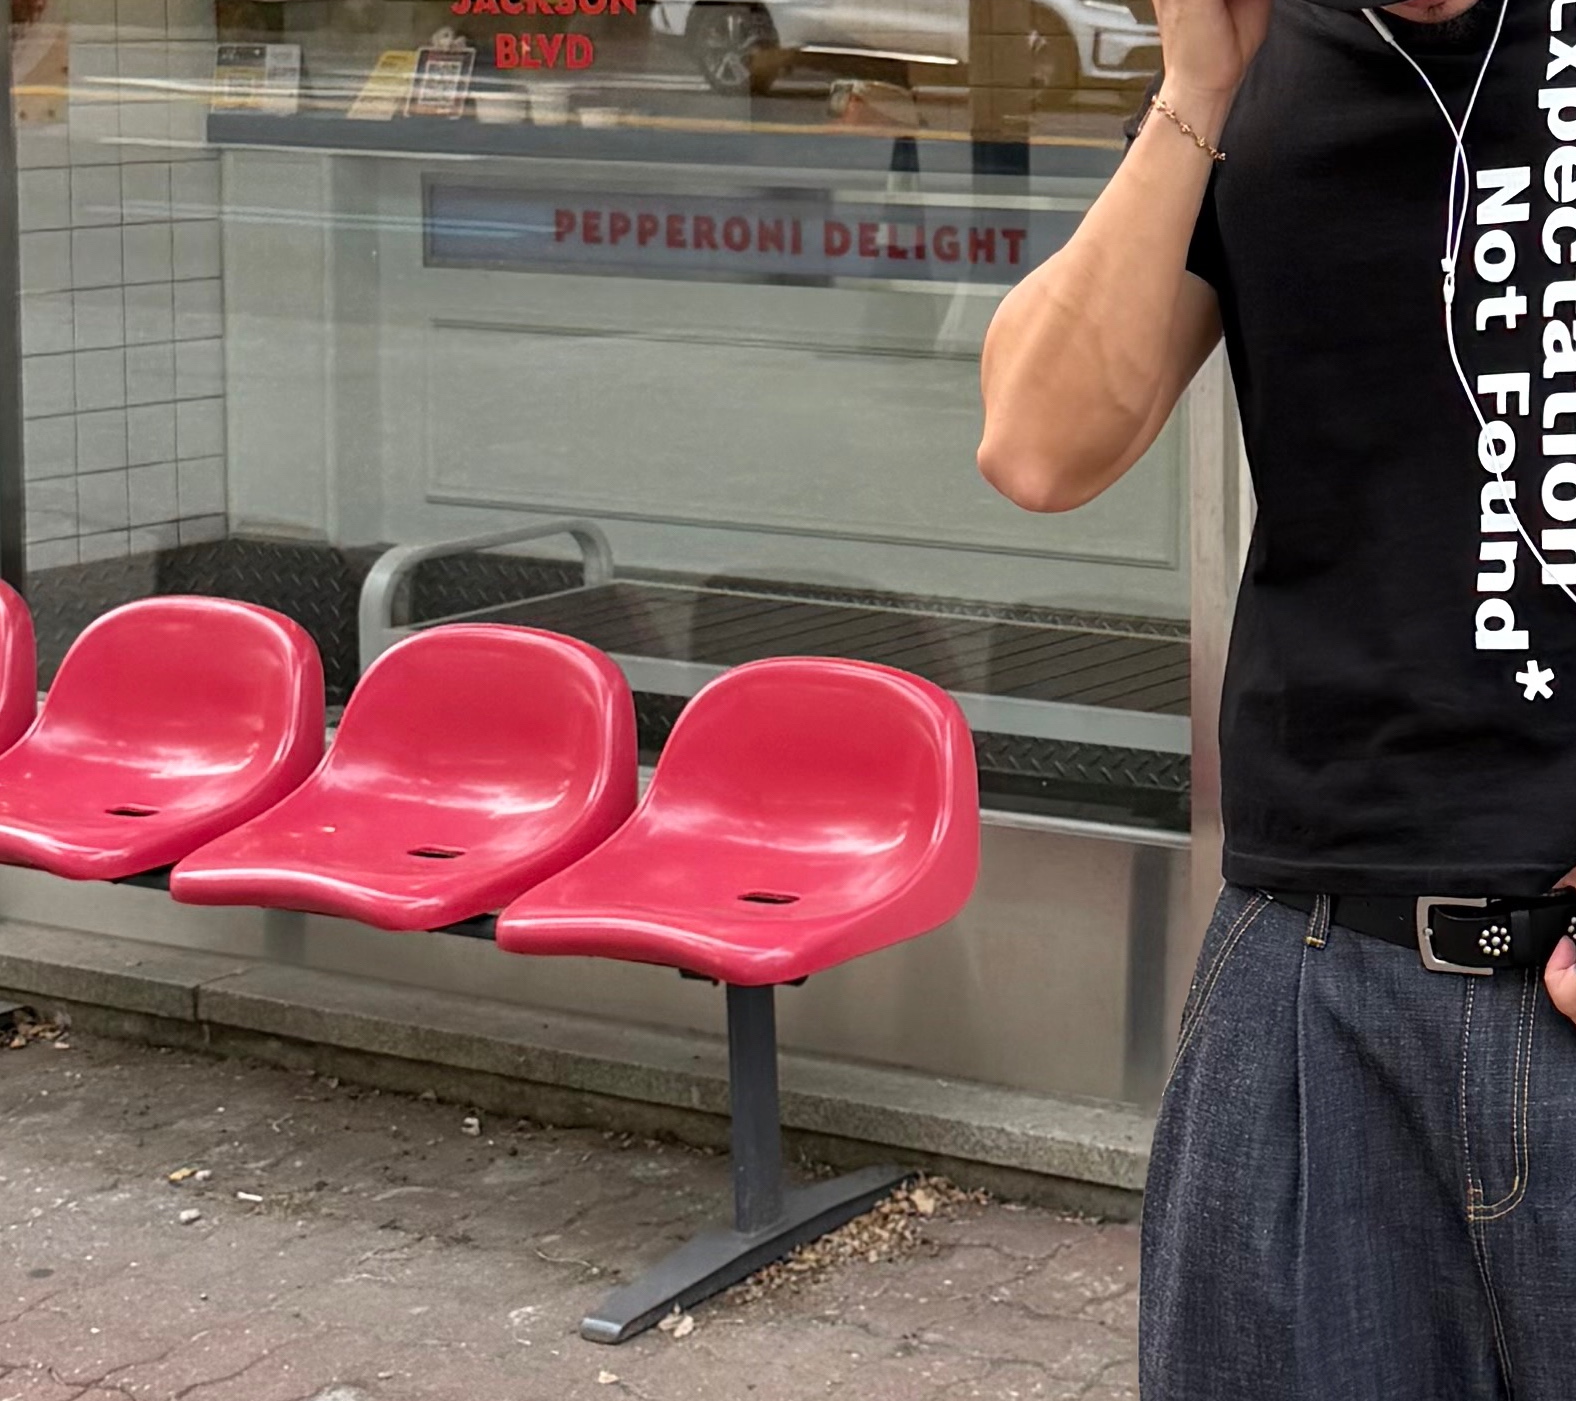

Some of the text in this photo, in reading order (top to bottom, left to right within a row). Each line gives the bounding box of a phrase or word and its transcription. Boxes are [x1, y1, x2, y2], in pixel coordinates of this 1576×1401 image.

[495, 32, 595, 70] BLVD
[554, 207, 1028, 266] PEPPERONI DELIGHT
[1473, 166, 1531, 332] Not
